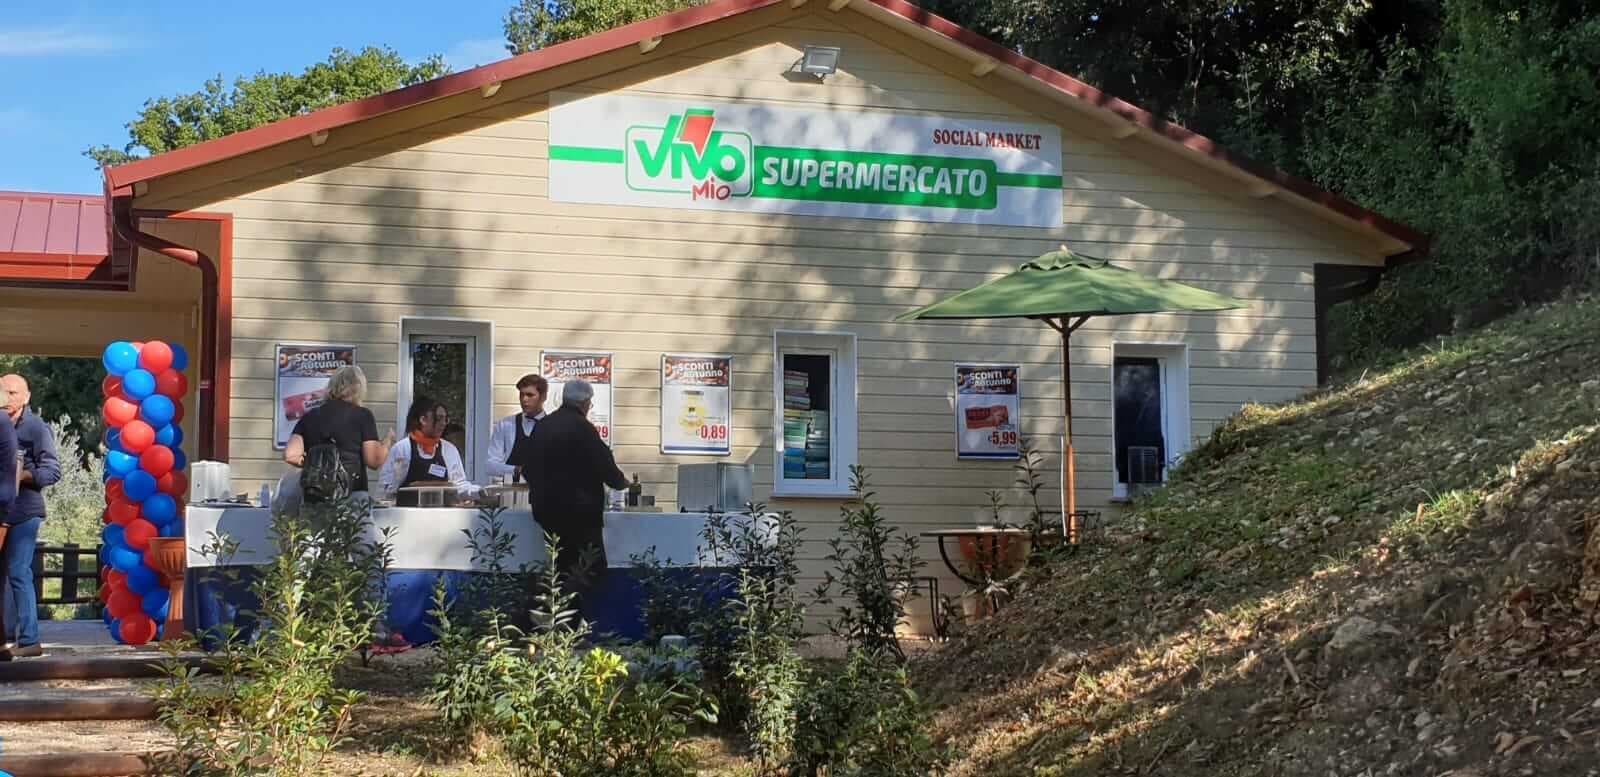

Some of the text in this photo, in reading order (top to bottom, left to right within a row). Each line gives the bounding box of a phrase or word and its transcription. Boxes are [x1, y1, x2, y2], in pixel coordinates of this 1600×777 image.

[933, 129, 1042, 150] SOCIAL MARKET
[761, 156, 988, 198] SUPERMERCATO
[295, 352, 335, 362] SCONTI
[558, 358, 595, 368] SCONTI
[677, 361, 714, 371] SCONTI
[969, 371, 1003, 381] SCONTI
